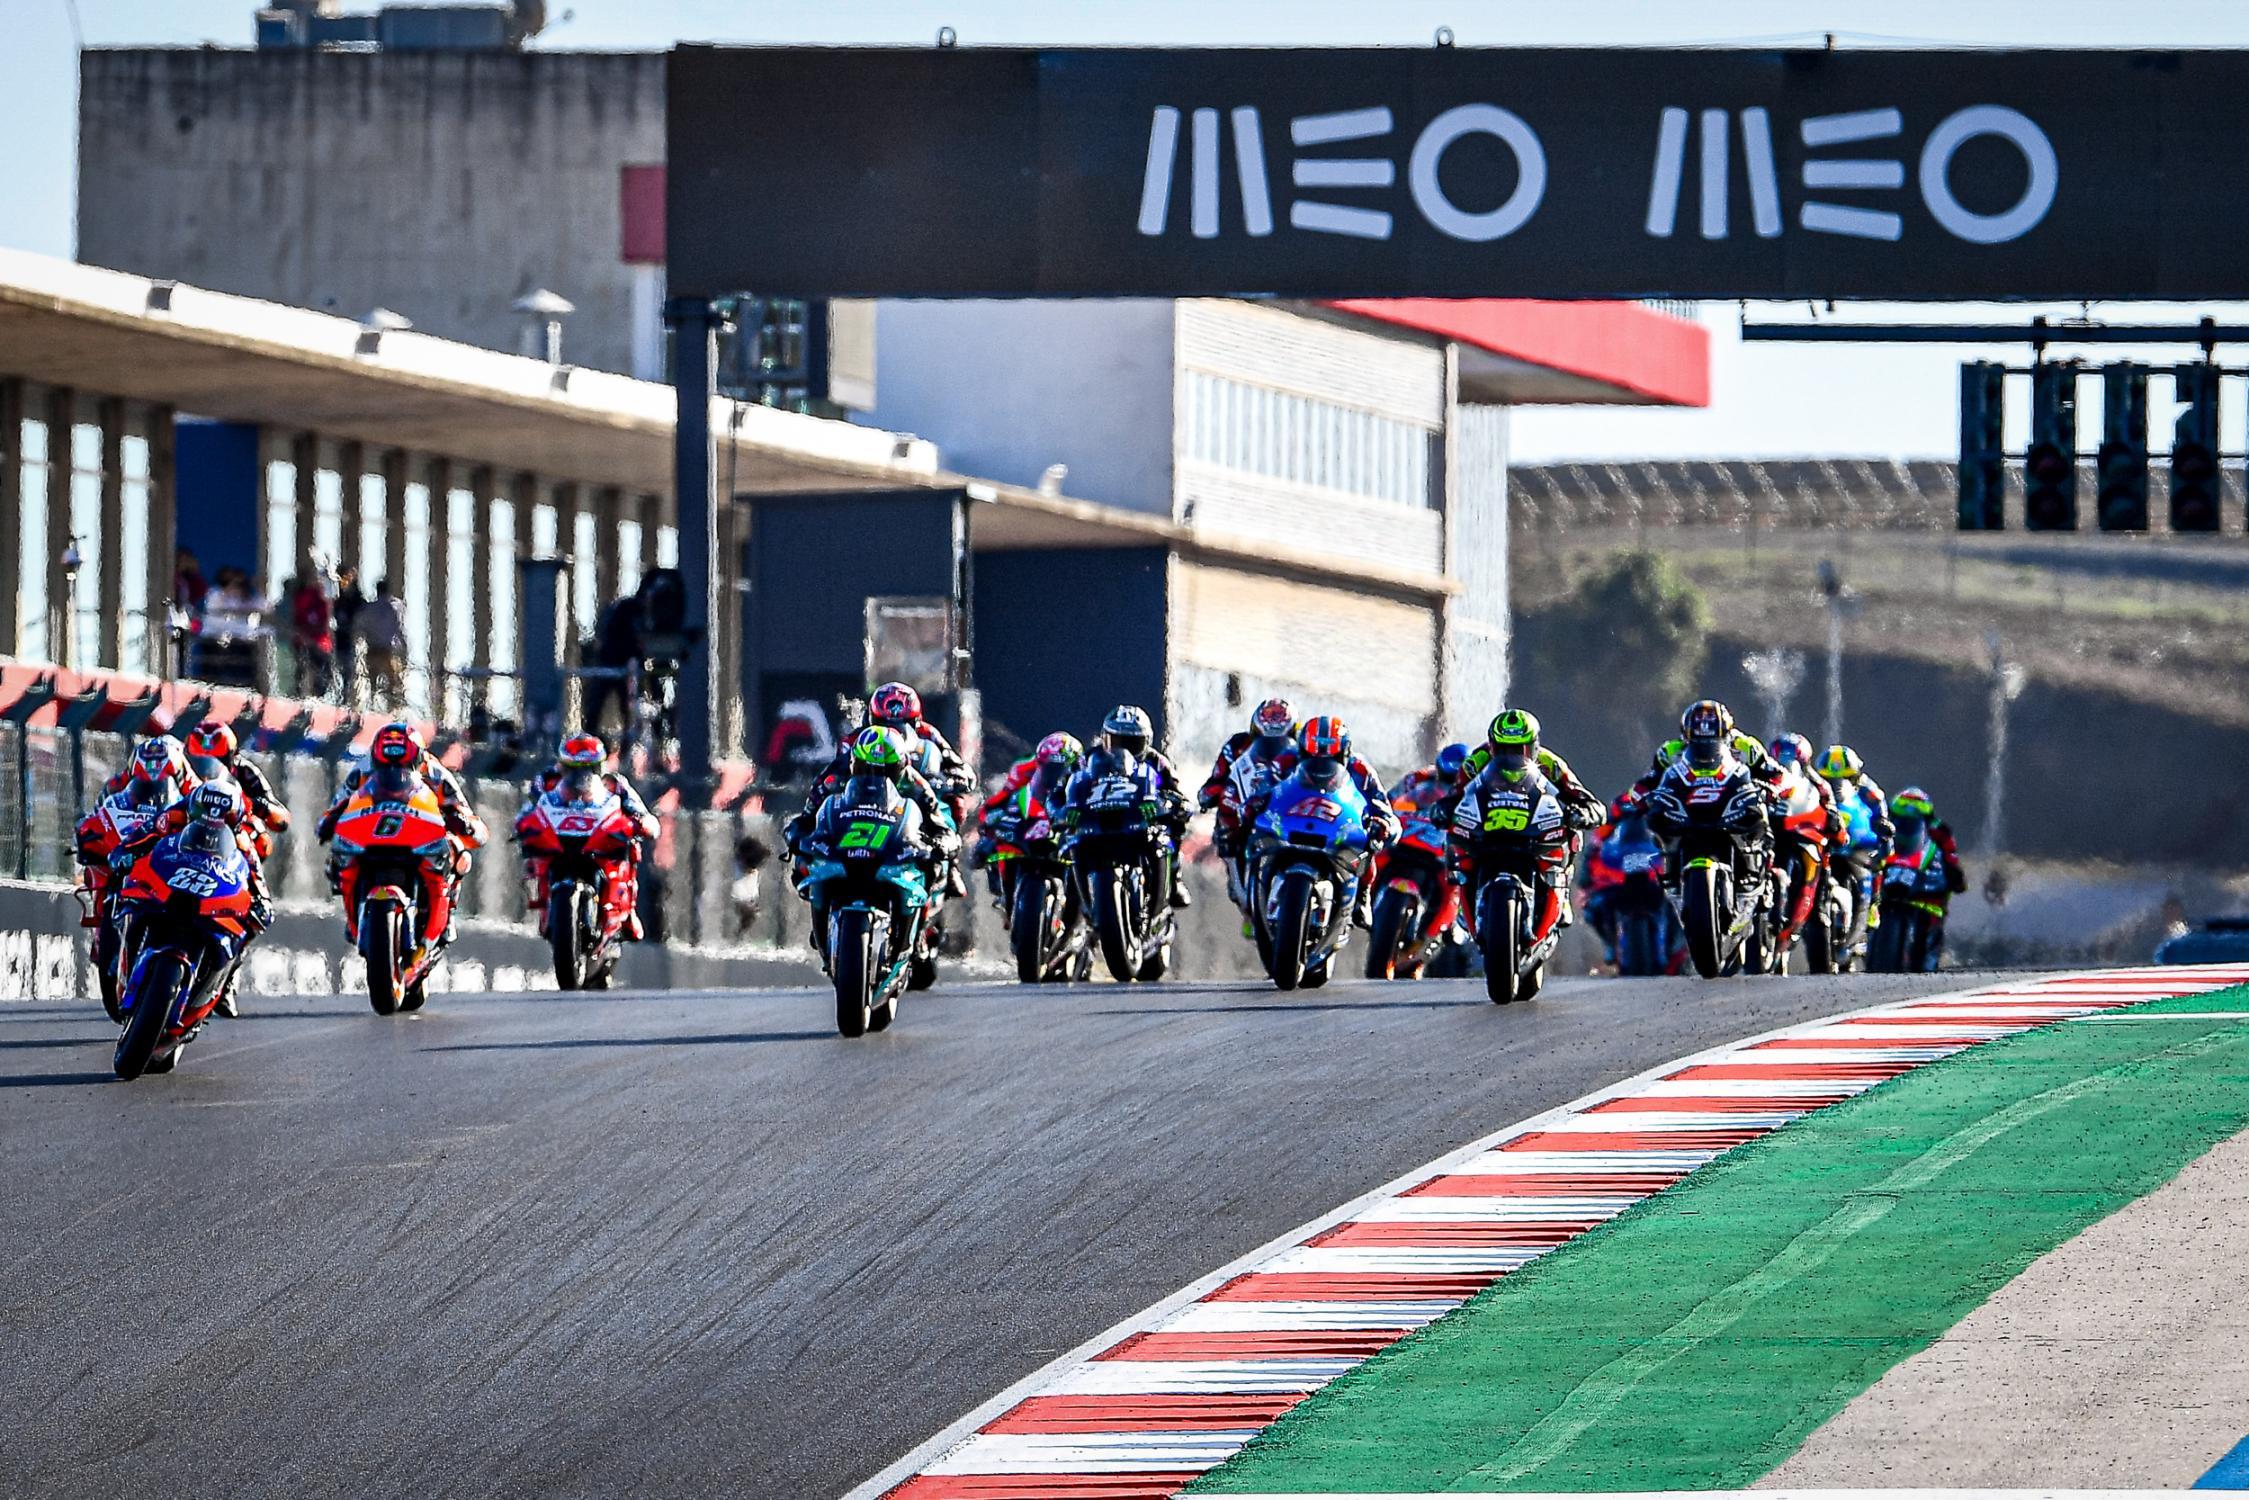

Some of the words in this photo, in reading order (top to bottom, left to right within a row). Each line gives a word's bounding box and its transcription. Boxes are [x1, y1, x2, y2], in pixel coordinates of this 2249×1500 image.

[1138, 103, 1547, 240] MEO
[1645, 105, 2059, 244] MEO
[1086, 782, 1138, 805] 12
[839, 810, 897, 823] PETRONAS
[1285, 797, 1342, 823] 42
[1483, 809, 1530, 832] 35
[838, 822, 891, 849] 21
